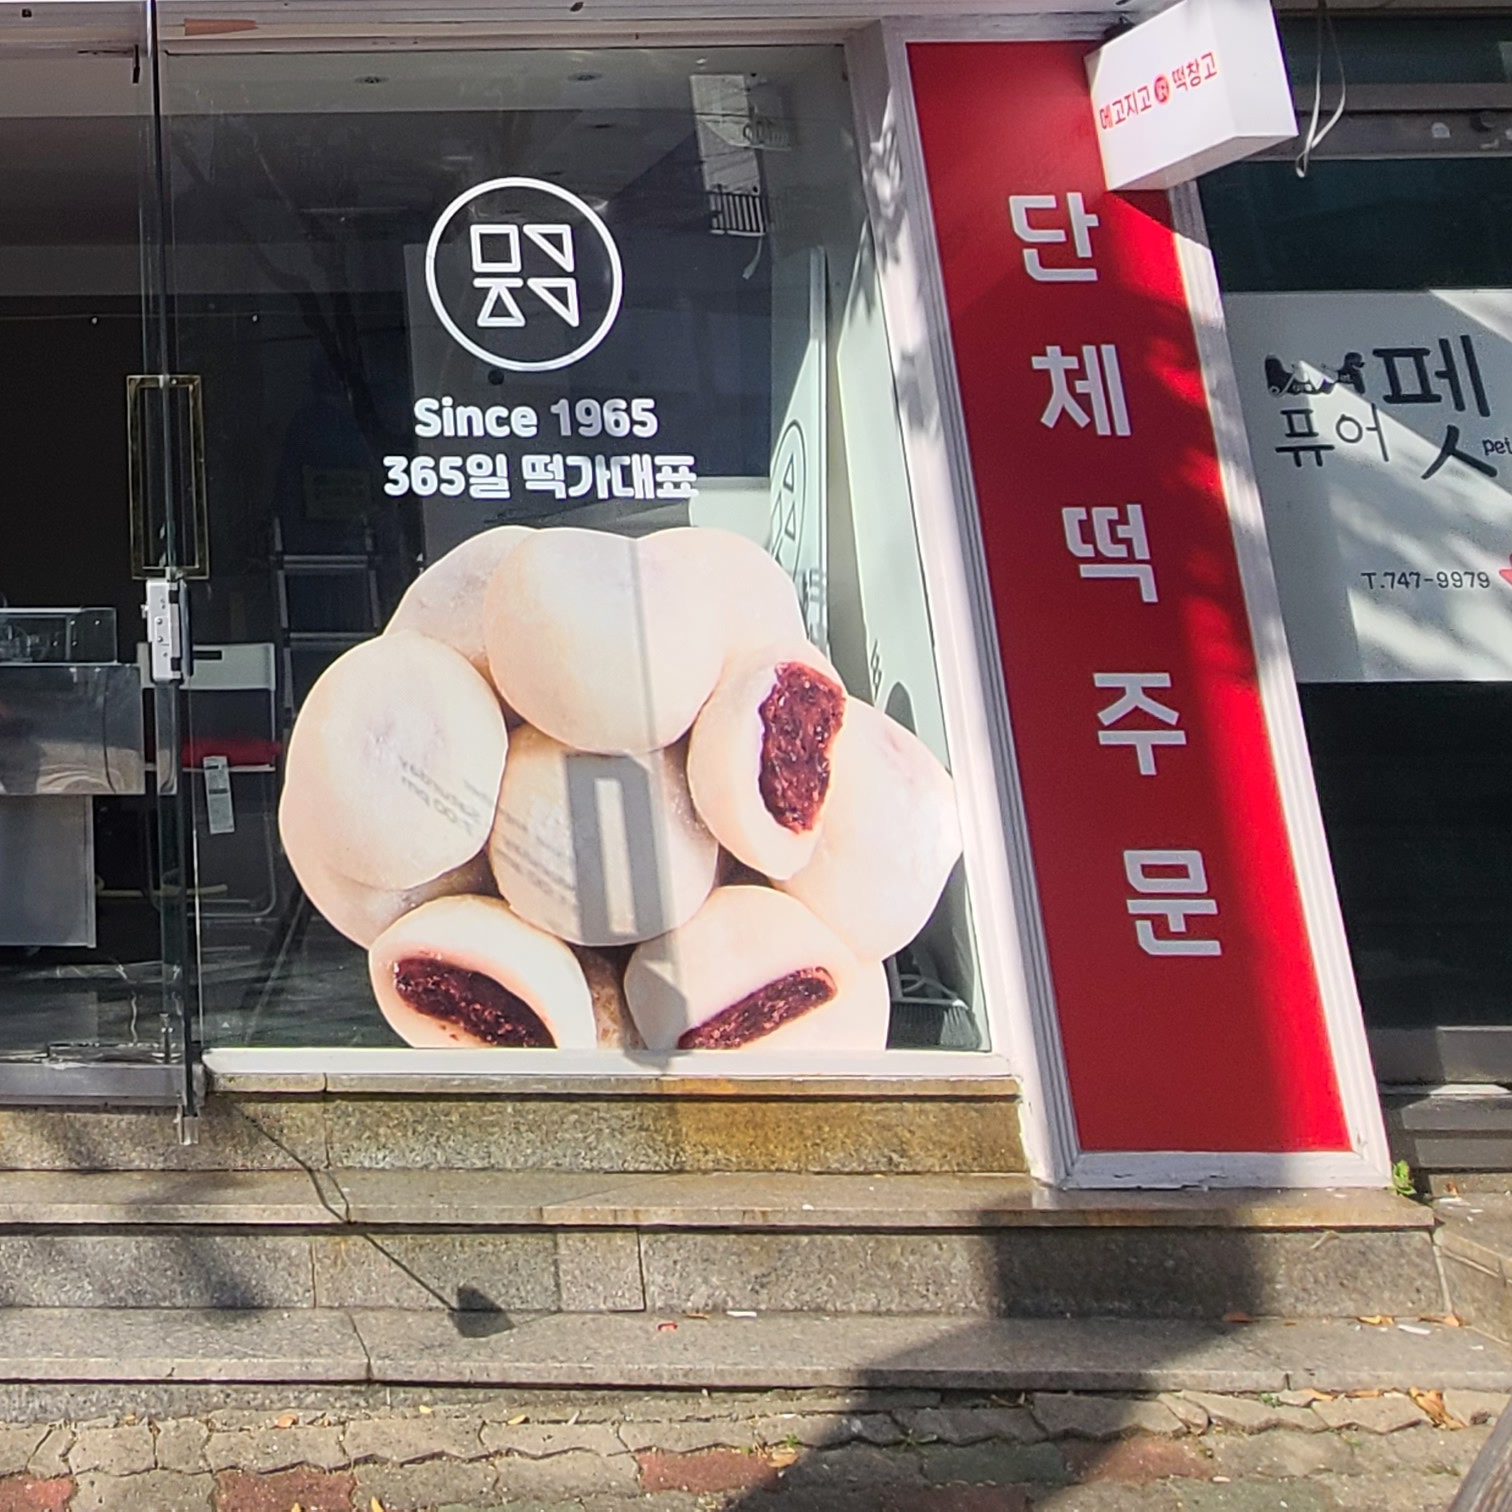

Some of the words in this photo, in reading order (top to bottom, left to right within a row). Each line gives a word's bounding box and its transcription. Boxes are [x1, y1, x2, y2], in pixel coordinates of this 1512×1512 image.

[1099, 85, 1152, 130] 메고지고
[1171, 51, 1218, 91] 떡창고
[413, 398, 538, 438] Since
[550, 398, 659, 438] 1965
[1275, 402, 1390, 468] 퓨어
[1372, 334, 1498, 480] 펫
[383, 455, 511, 499] 365일
[521, 454, 700, 500] 떡가대표
